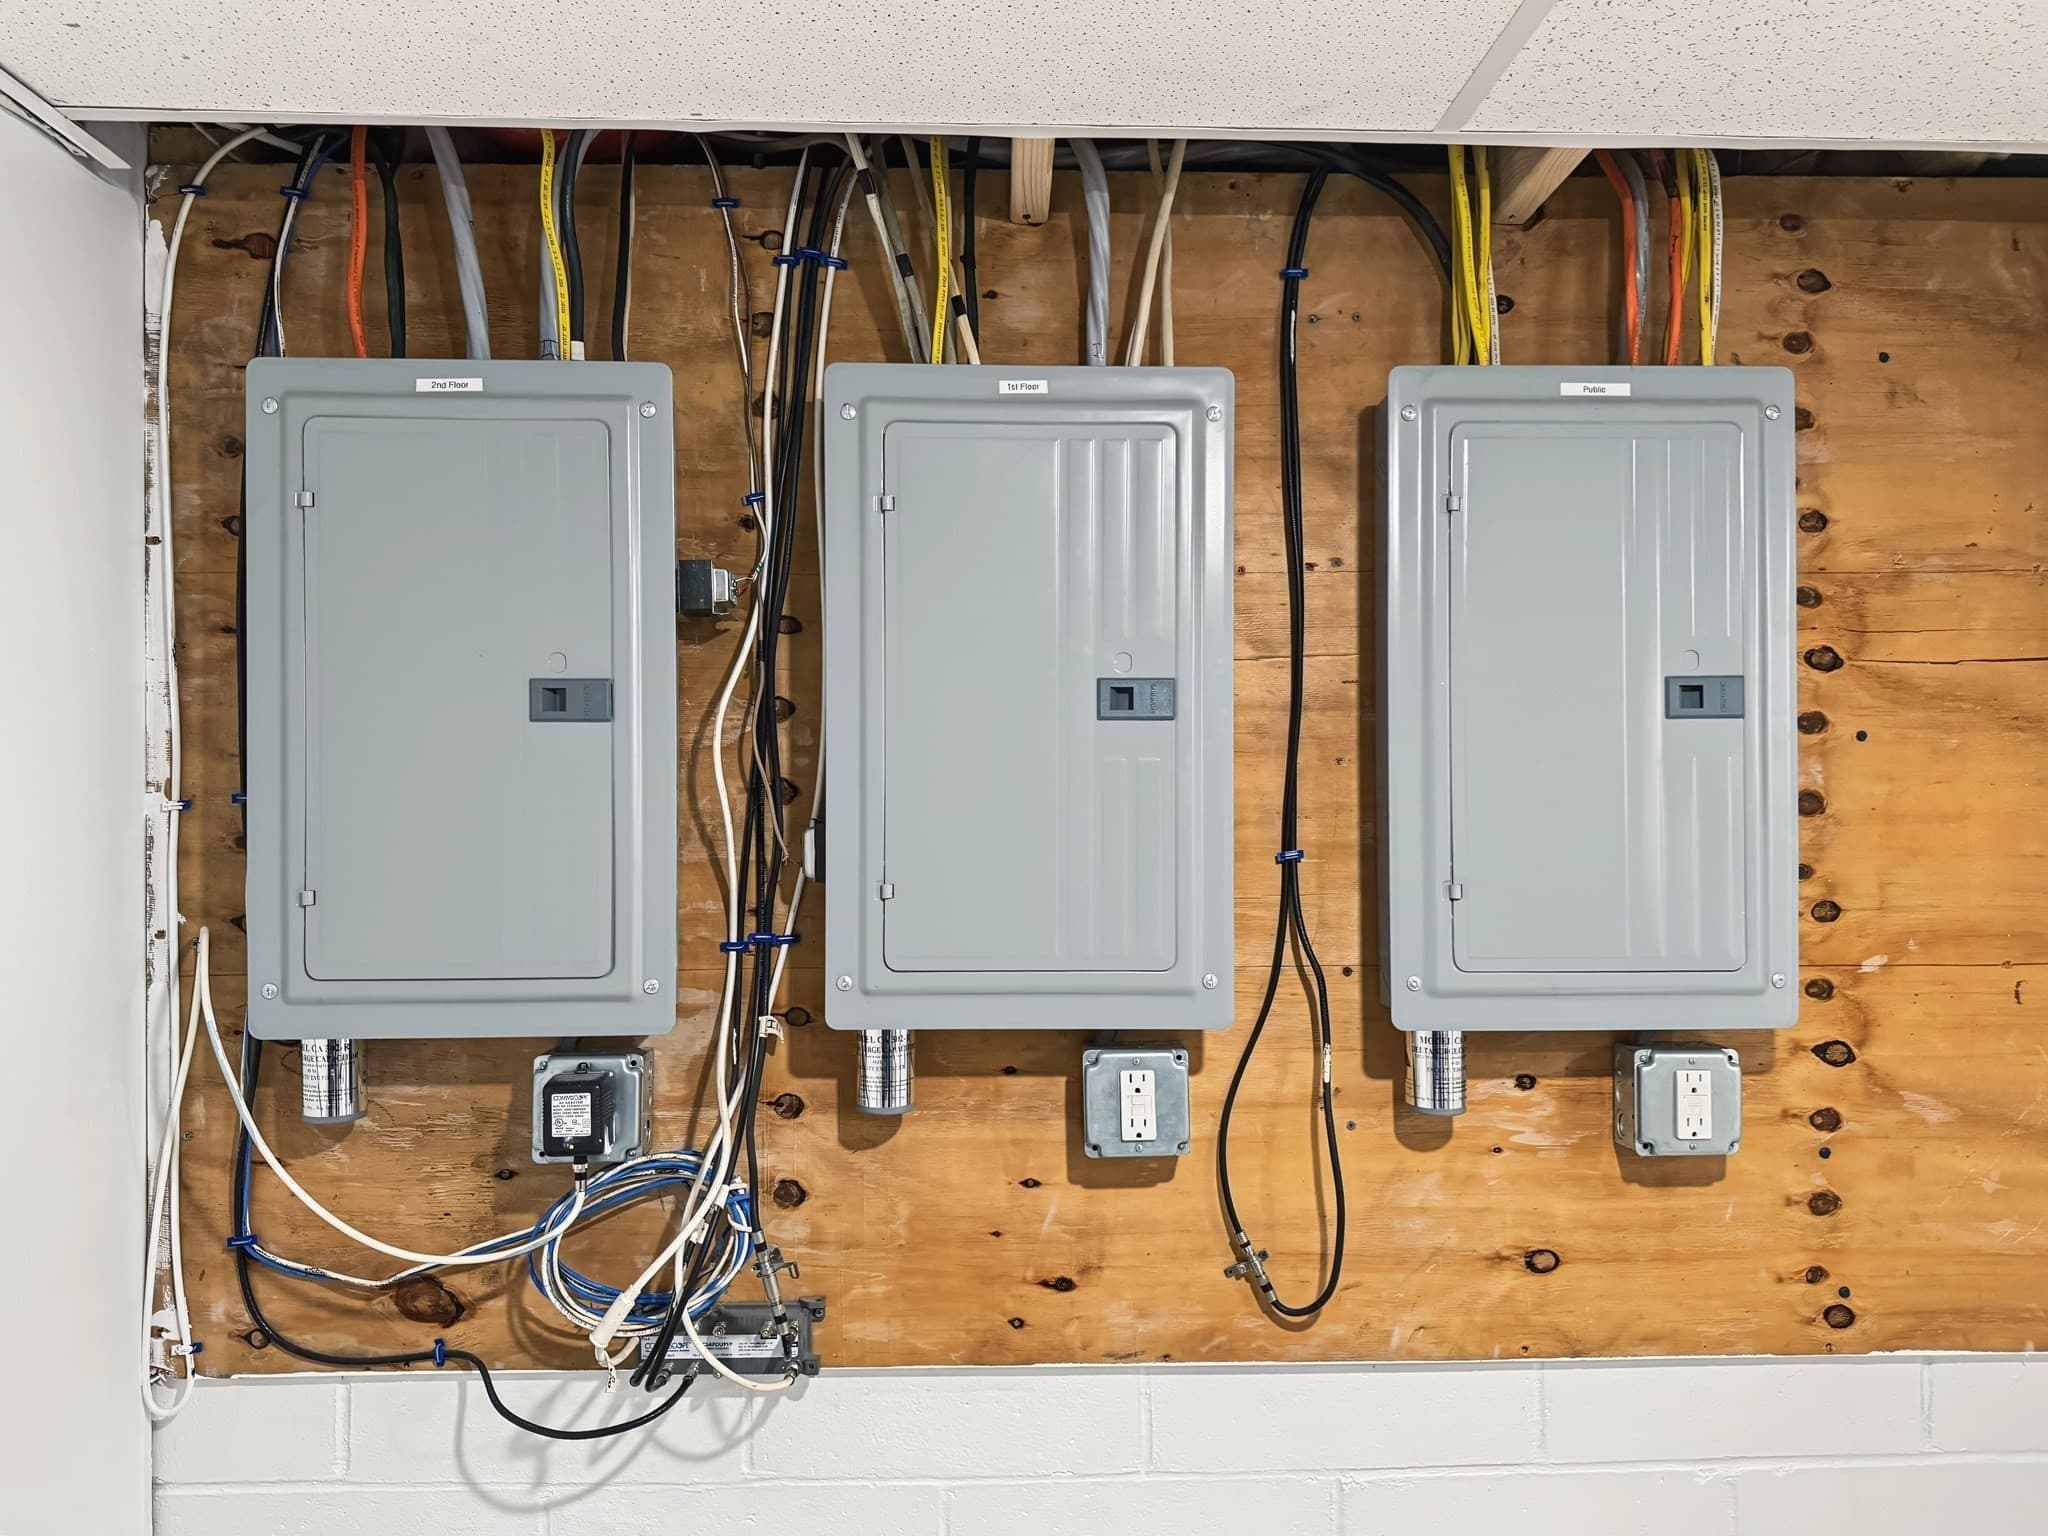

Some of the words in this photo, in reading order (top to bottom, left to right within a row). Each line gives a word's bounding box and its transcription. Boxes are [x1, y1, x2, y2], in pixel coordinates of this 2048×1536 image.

[431, 381, 446, 389] 2nd
[448, 381, 469, 389] Floor
[1007, 383, 1018, 391] 1st
[1020, 383, 1040, 391] Floor
[1583, 385, 1607, 393] Public
